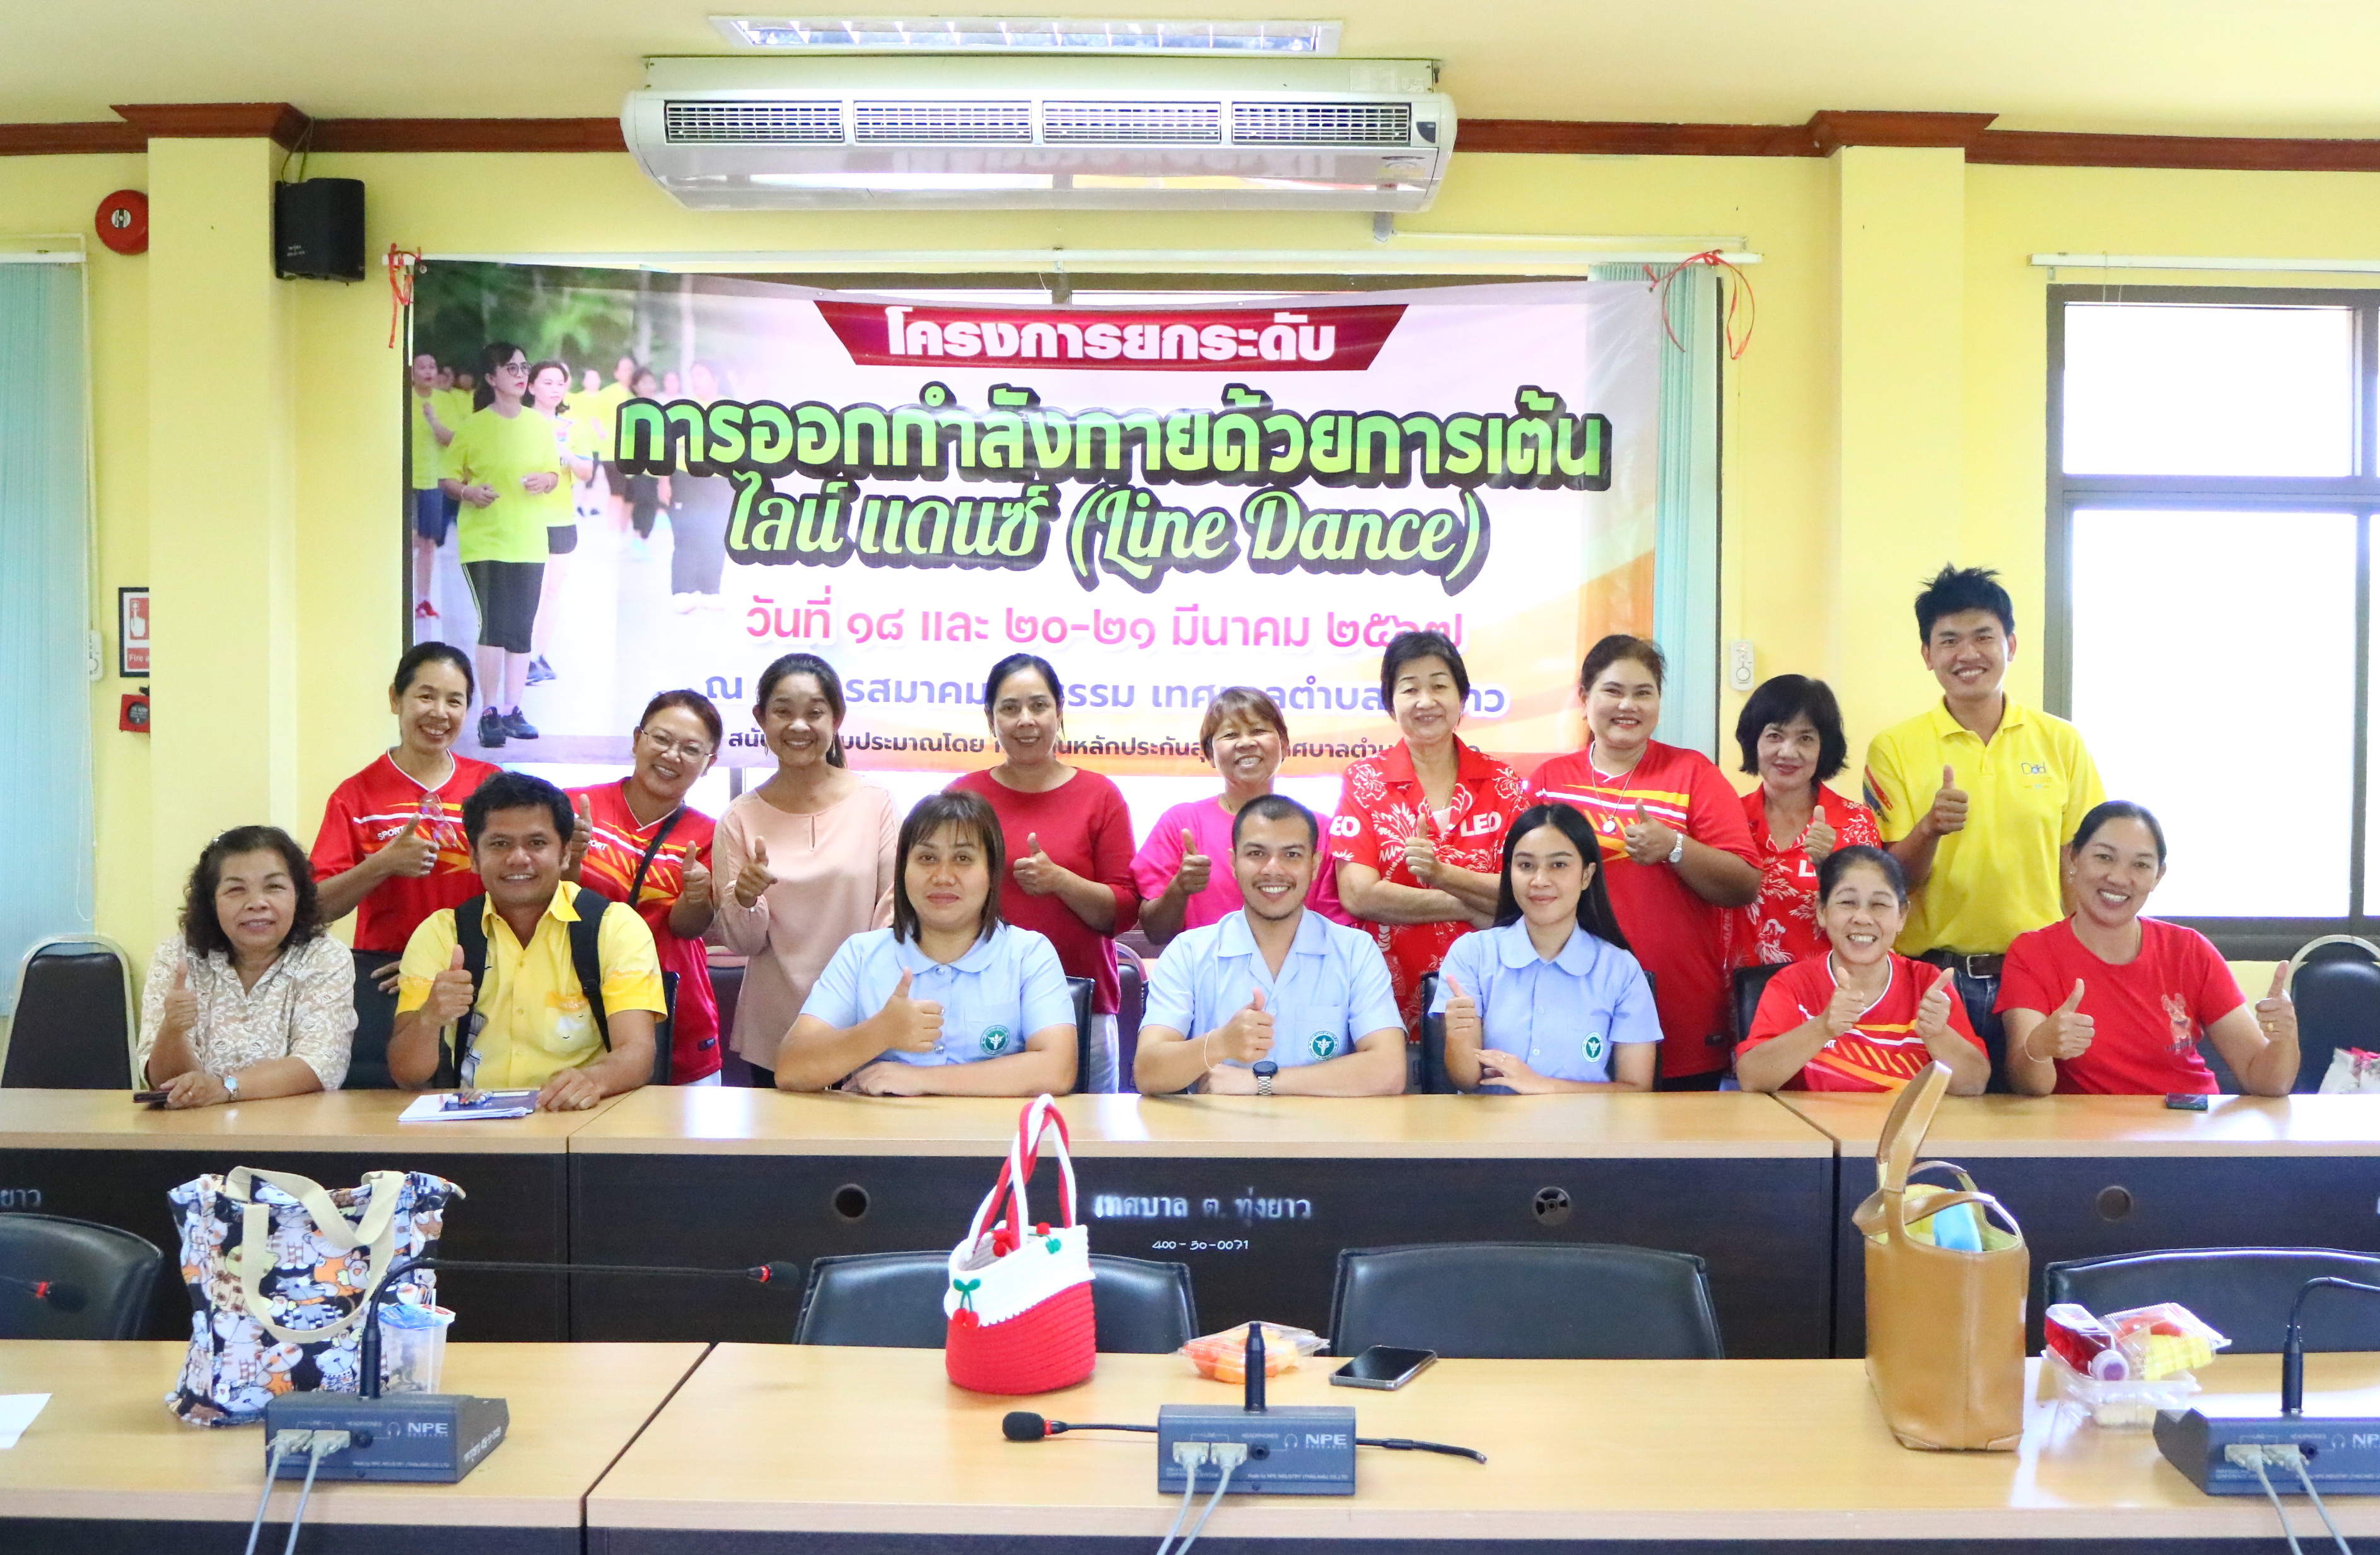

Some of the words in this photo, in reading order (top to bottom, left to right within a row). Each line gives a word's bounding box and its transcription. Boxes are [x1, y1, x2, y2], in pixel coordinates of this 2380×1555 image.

[885, 306, 1335, 361] โครงการยกระดับ
[618, 383, 1605, 480] การออกกำลังกายด้วยการเต้น
[728, 470, 849, 555] ไลน์
[856, 484, 1049, 557] แดนซ์
[1071, 487, 1230, 581] (Line
[1244, 489, 1479, 582] Dance)
[746, 585, 831, 639] วันที่
[846, 608, 904, 644] ๑๘
[921, 610, 989, 642] และ
[1172, 603, 1310, 648] มีนาคม
[705, 676, 743, 700] ณ
[1323, 815, 1361, 837] EO
[1094, 1196, 1189, 1218] เทศบาล
[407, 1422, 448, 1433] NPE
[1305, 1433, 1347, 1445] NPE
[2352, 1433, 2380, 1445] NP
